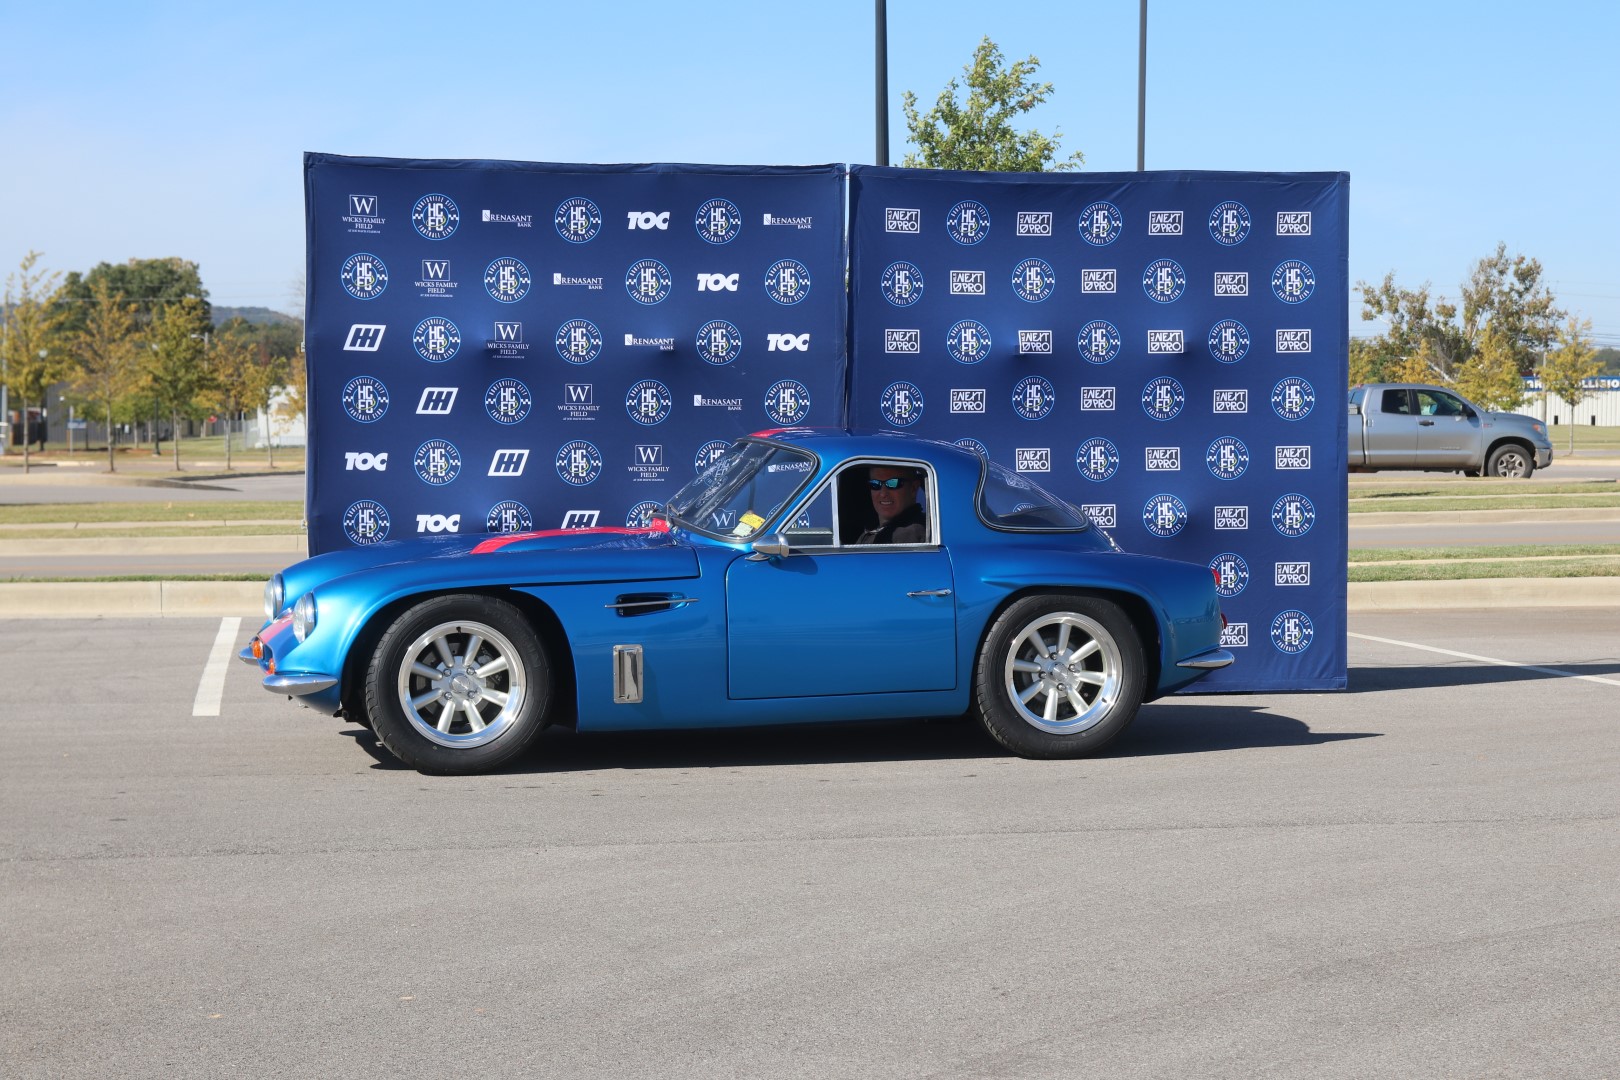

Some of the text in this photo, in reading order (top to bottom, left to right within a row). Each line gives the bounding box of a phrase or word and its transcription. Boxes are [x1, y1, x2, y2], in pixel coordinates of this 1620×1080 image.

[352, 197, 375, 214] W
[490, 213, 532, 222] RENASANT
[627, 211, 670, 230] TOC
[771, 216, 812, 224] RENASANT
[892, 211, 917, 221] NEXT
[1023, 215, 1049, 224] NEXT
[1155, 214, 1181, 223] NEXT
[1283, 214, 1308, 224] NEXT
[425, 263, 447, 280] W
[561, 276, 603, 284] RENASANT
[957, 273, 982, 283] NEXT
[1088, 272, 1113, 281] NEXT
[1220, 275, 1245, 284] NEXT
[697, 273, 740, 291] TOC
[498, 325, 519, 342] W
[892, 332, 917, 341] NEXT
[1024, 333, 1049, 342] NEXT
[1153, 333, 1177, 342] NEXT
[1283, 332, 1308, 341] NEXT
[632, 337, 674, 345] RENASANT
[767, 333, 810, 351] TOC
[568, 387, 590, 404] W
[957, 392, 983, 401] NEXT
[1088, 390, 1112, 399] NEXT
[1220, 392, 1245, 401] NEXT
[702, 397, 742, 405] RENASANT
[638, 448, 659, 465] W
[1023, 451, 1048, 460] NEXT
[1152, 450, 1178, 459] NEXT
[1282, 448, 1308, 458] NEXT
[345, 452, 388, 471] TOC
[1088, 506, 1113, 516] NEXT
[1220, 509, 1245, 518] NEXT
[416, 514, 461, 533] TOC
[1282, 565, 1307, 574] NEXT
